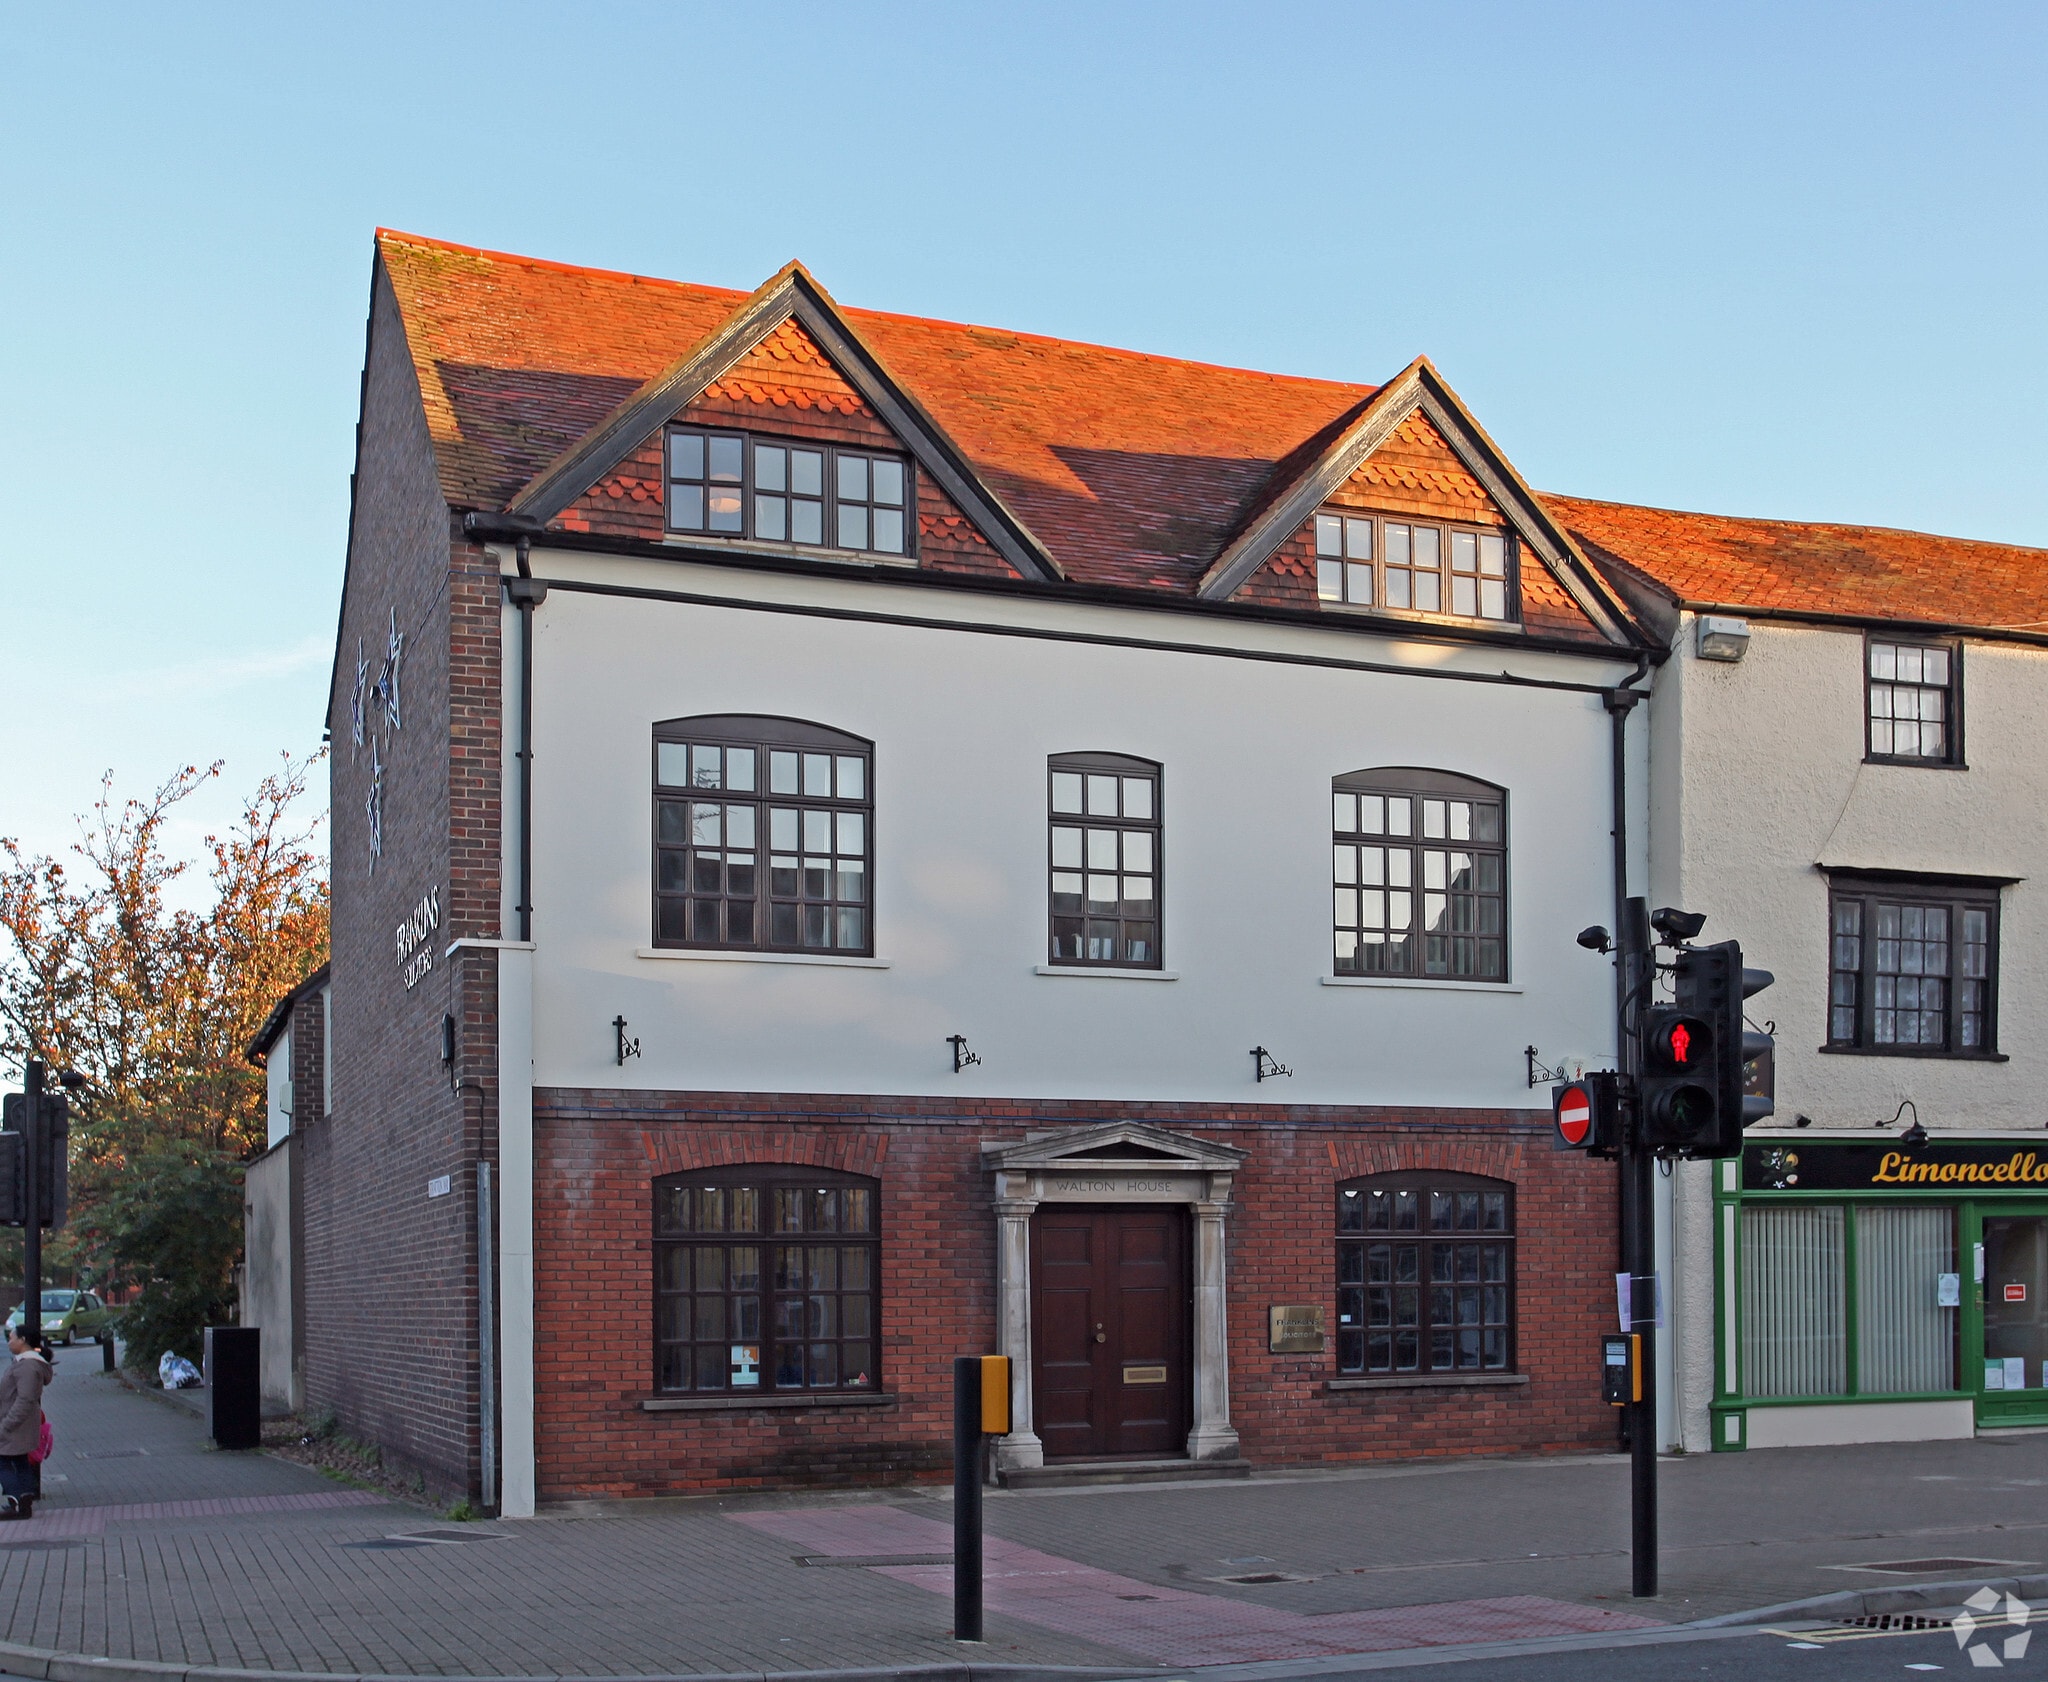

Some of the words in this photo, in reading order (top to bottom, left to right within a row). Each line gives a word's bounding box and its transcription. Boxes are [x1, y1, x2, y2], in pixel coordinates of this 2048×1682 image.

[396, 885, 439, 966] FRANKLINS
[1871, 1151, 2048, 1183] Limoncello
[1056, 1181, 1115, 1192] WALTON
[1127, 1181, 1172, 1192] HOUSE
